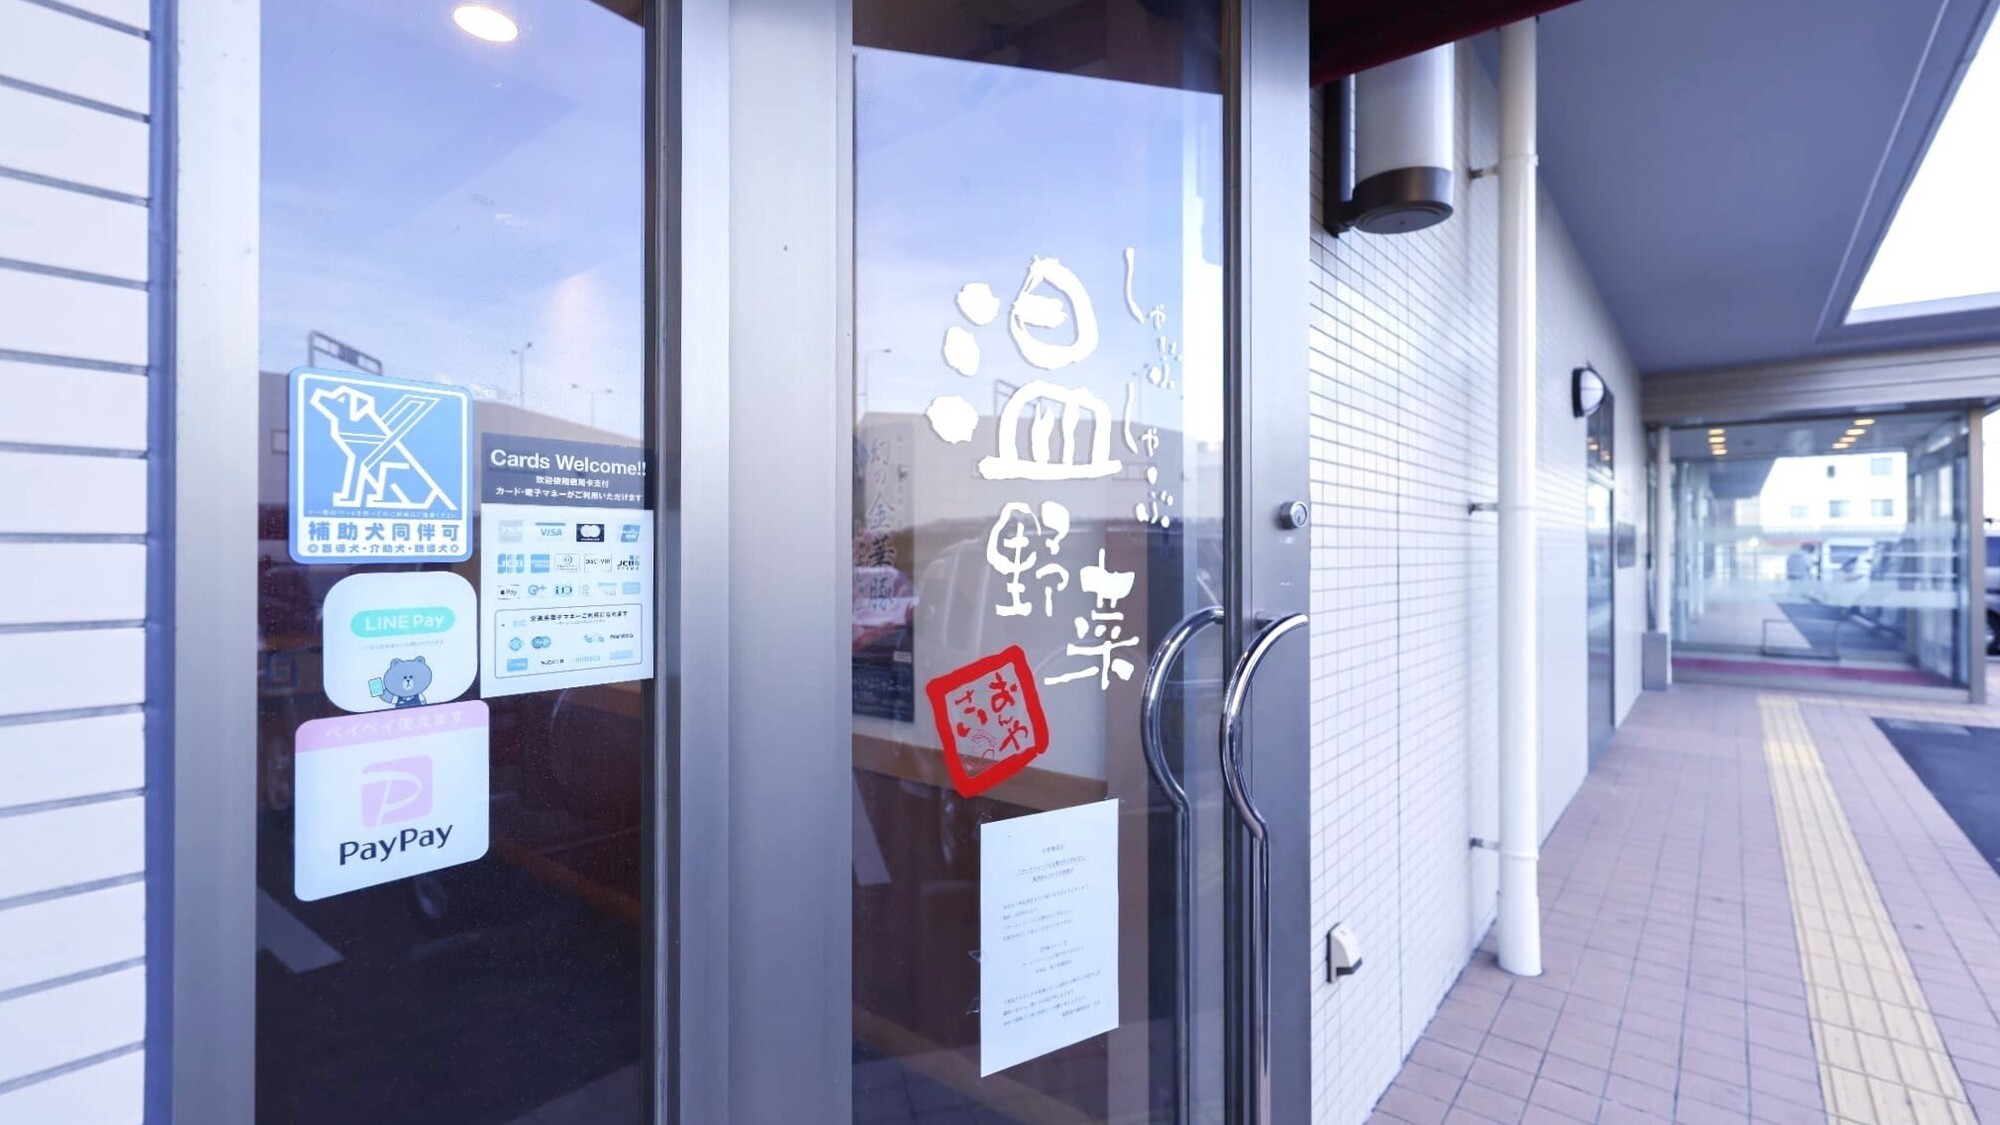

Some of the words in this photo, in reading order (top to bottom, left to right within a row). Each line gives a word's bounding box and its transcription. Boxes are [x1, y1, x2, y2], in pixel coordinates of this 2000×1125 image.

[490, 449, 550, 469] Cards
[555, 453, 647, 476] Welcome!!
[925, 255, 1140, 691] 温野菜
[308, 521, 459, 541] 補助犬同伴可
[540, 528, 563, 537] VISA
[365, 615, 410, 631] LINE
[412, 614, 445, 629] Pay
[325, 711, 462, 738] ペイペイ使えます
[338, 824, 454, 866] PayPay
